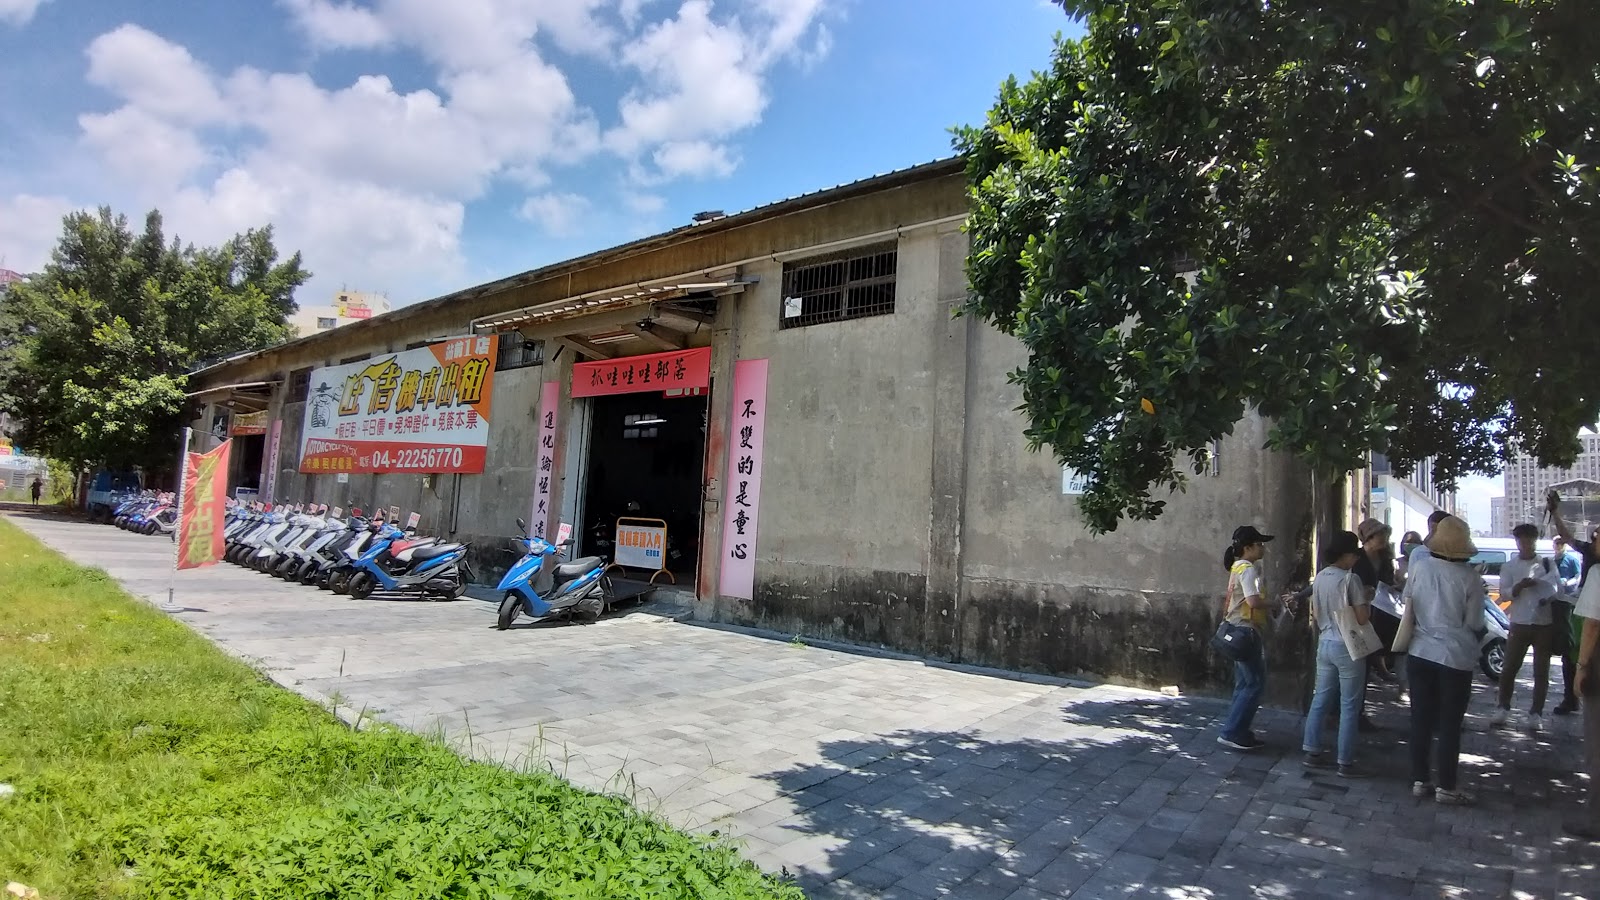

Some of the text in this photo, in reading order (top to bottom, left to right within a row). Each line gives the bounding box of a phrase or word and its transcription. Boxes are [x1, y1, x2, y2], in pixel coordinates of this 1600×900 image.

[372, 447, 463, 469] 04-22256770
[731, 398, 757, 560] 不變的是童心
